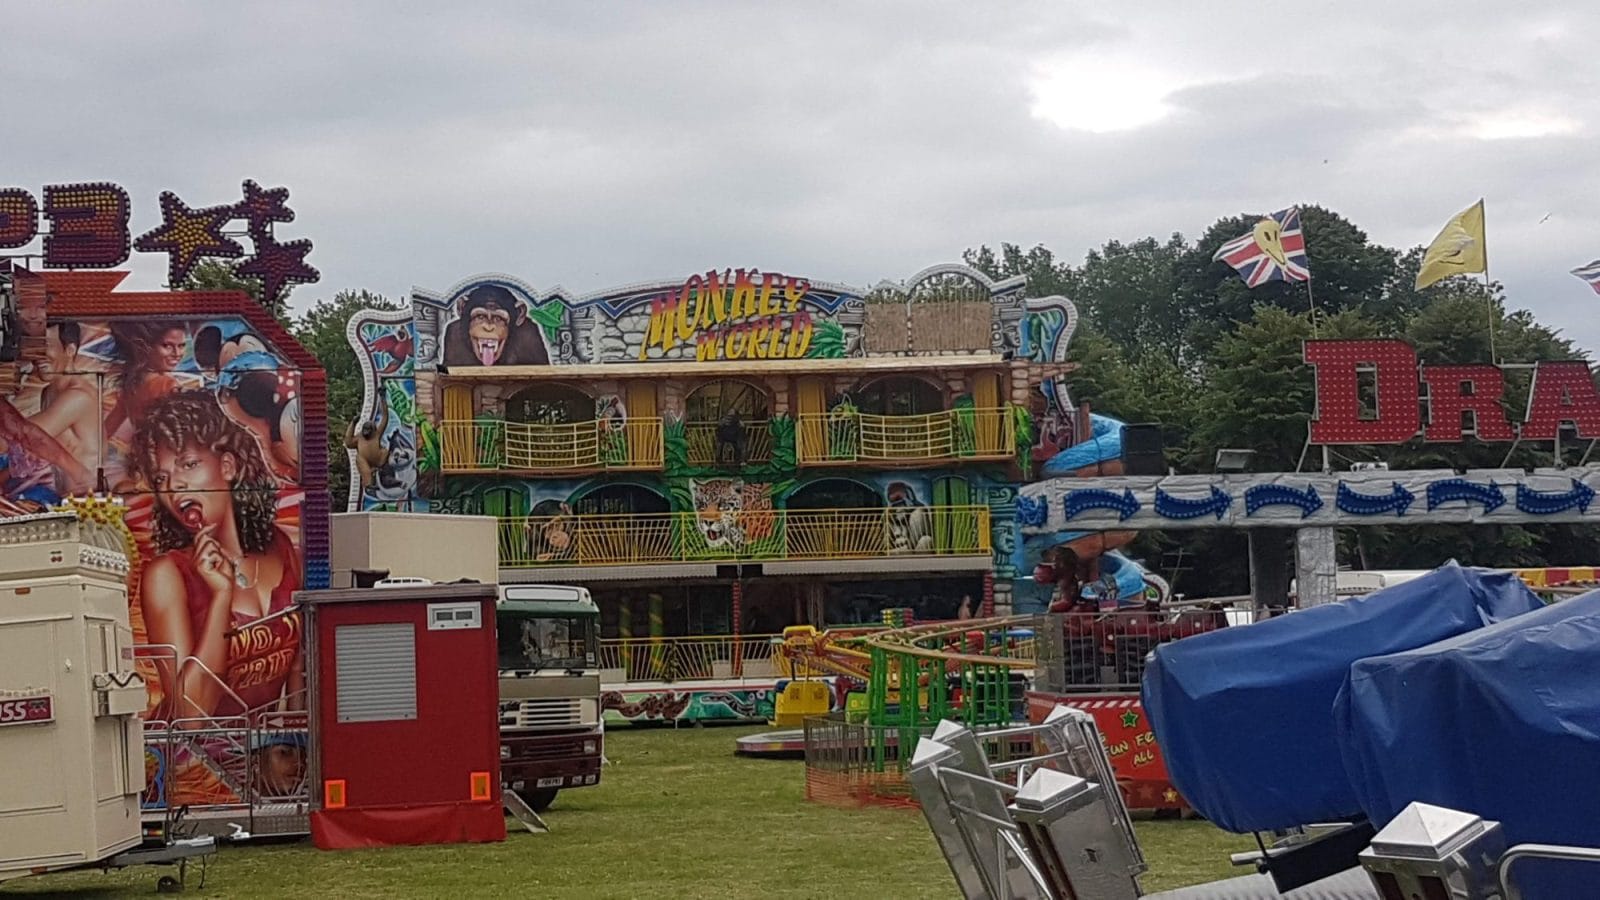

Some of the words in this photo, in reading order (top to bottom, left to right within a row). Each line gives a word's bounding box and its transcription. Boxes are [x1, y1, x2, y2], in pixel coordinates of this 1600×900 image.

[639, 267, 810, 361] MONKEY
[697, 311, 812, 361] WORLD
[1133, 749, 1154, 766] ALL
